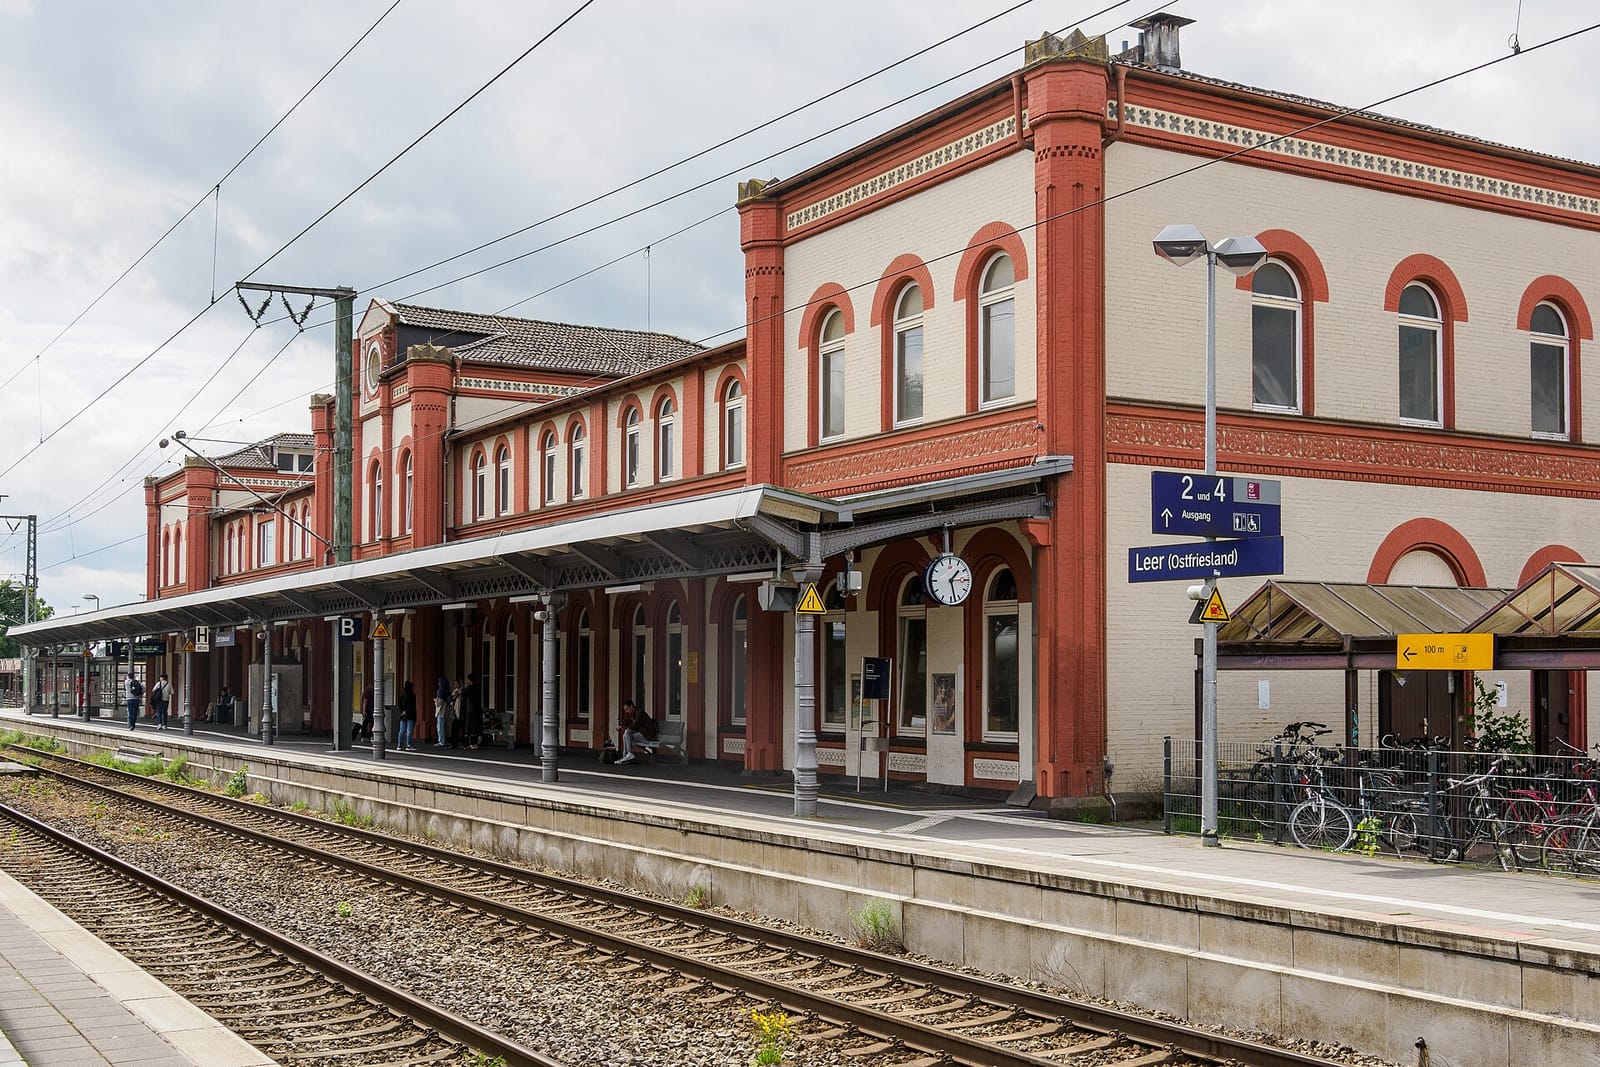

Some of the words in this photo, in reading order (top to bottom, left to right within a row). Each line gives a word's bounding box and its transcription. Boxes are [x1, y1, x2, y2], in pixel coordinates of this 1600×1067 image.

[1181, 475, 1193, 500] 2
[1197, 492, 1210, 501] und
[1214, 478, 1226, 502] 4
[1181, 509, 1211, 522] Ausgang
[1135, 552, 1165, 571] Leer
[1168, 548, 1238, 571] (Ostfriesland)
[197, 627, 207, 643] H
[341, 618, 355, 637] B
[1424, 645, 1436, 654] 100
[1437, 646, 1445, 654] m
